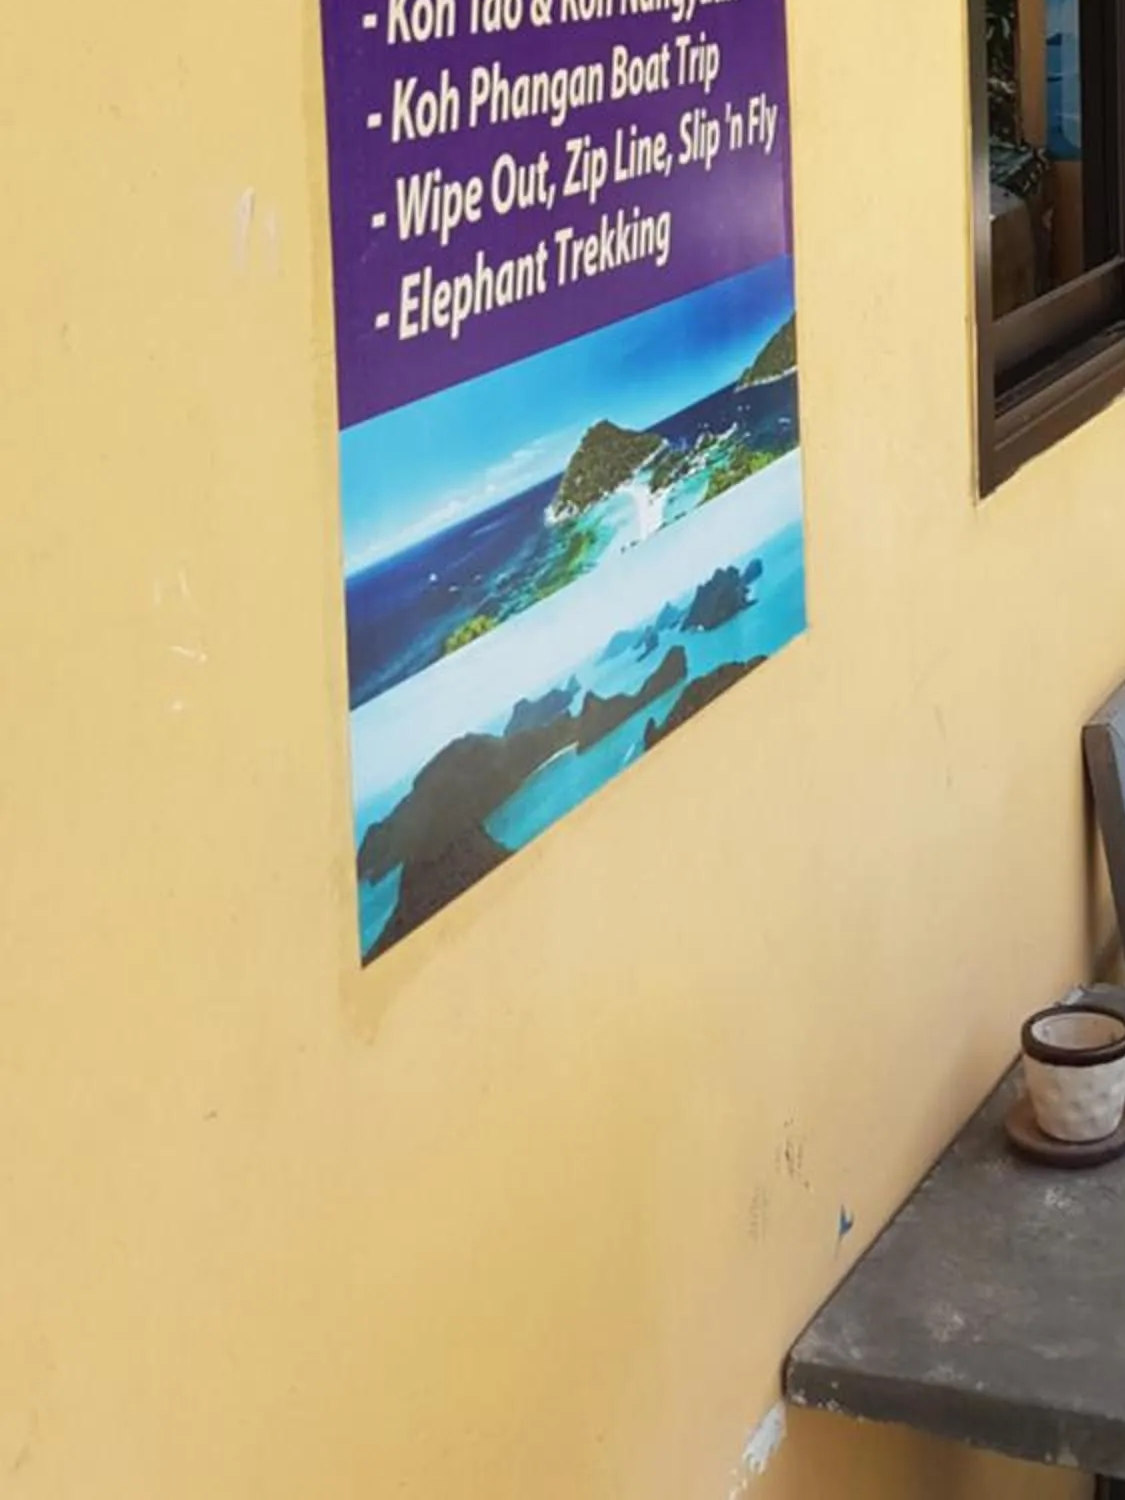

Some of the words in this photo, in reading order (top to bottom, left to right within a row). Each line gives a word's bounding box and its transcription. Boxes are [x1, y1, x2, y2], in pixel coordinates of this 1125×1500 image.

[391, 69, 459, 143] Koh
[469, 61, 604, 128] Phangan
[610, 42, 670, 99] Boat
[675, 31, 720, 94] Trip
[397, 168, 483, 246] Wipe
[491, 150, 556, 210] Out,
[563, 135, 608, 204] Zip
[615, 125, 672, 182] Line,
[679, 107, 720, 171] Slip
[748, 93, 778, 154] Fly
[399, 250, 549, 340] Elephant
[555, 206, 671, 286] Trekking
